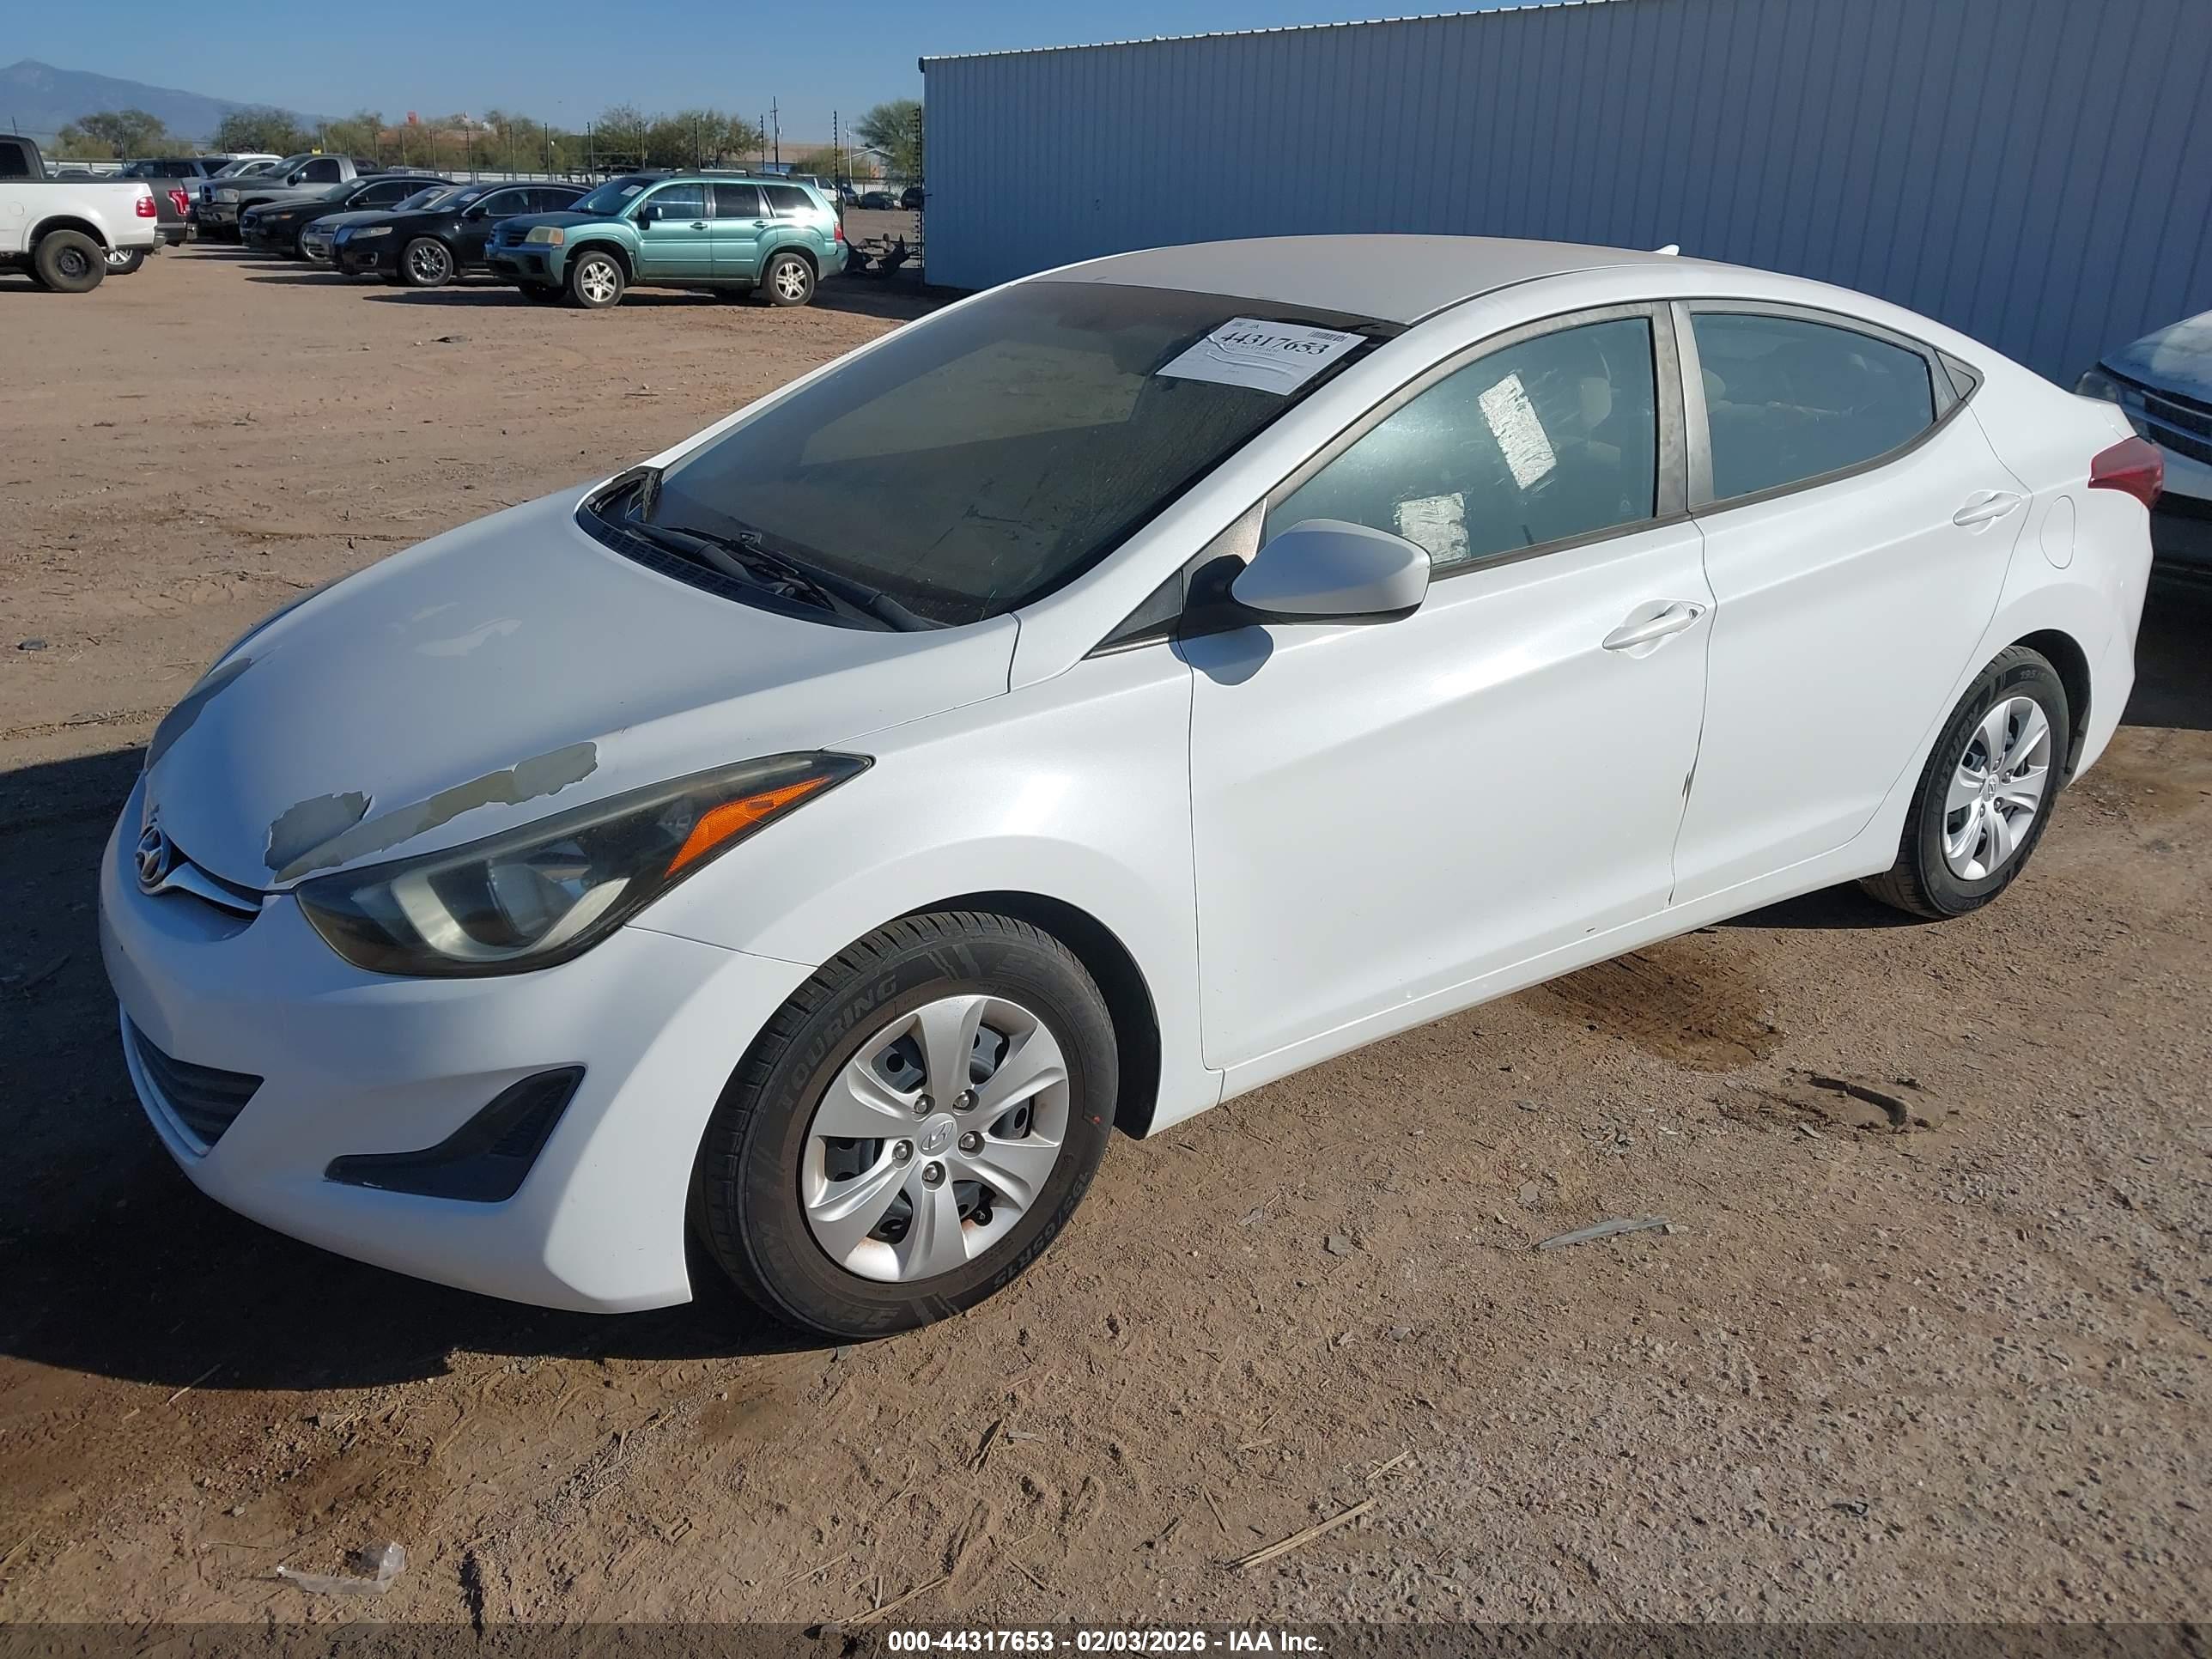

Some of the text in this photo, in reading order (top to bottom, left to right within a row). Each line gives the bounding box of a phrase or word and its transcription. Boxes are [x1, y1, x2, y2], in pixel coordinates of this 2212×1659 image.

[1219, 331, 1331, 356] 44317653
[775, 973, 899, 1111] TOURING
[993, 1170, 1091, 1288] 195/65R15
